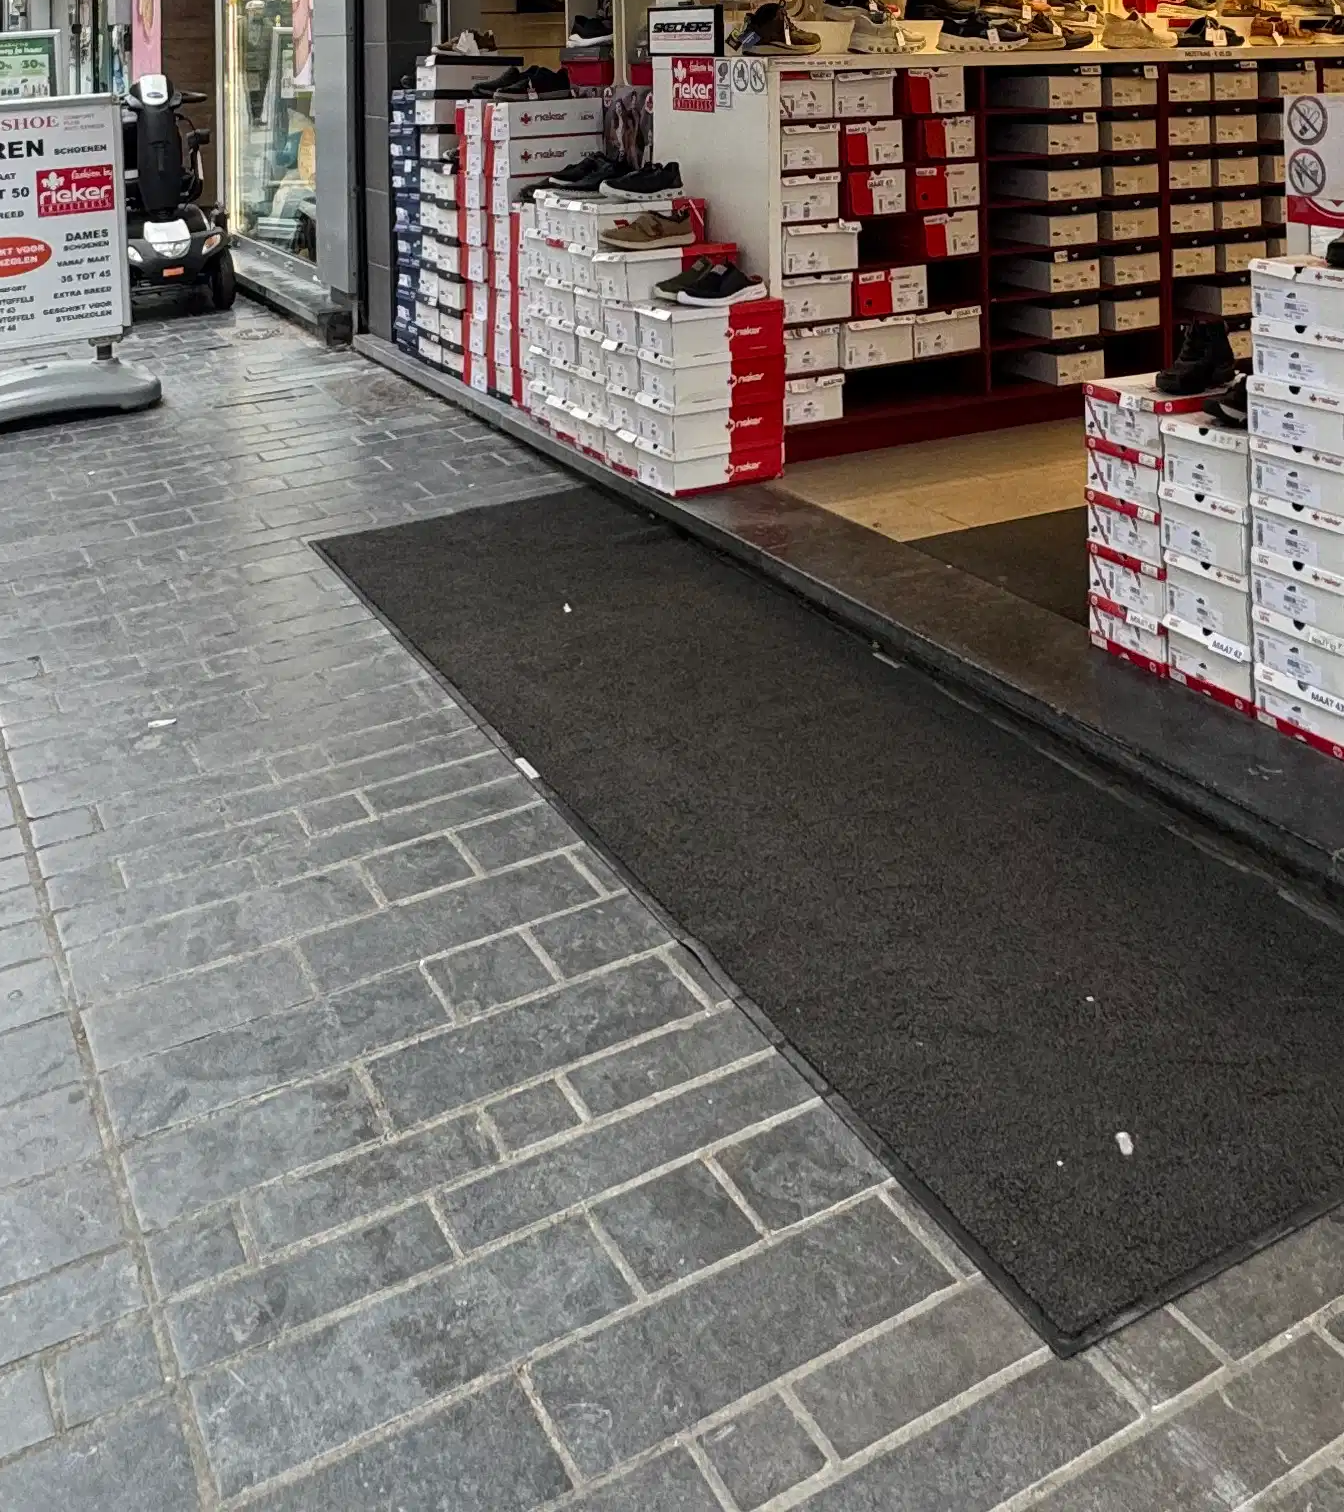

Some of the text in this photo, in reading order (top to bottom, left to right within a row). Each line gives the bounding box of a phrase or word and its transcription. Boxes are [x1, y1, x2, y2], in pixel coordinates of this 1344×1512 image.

[652, 21, 714, 34] SKECHERS
[673, 76, 712, 100] rieker
[1, 116, 59, 132] SHOE
[54, 144, 107, 155] SCHOENEN
[11, 187, 30, 198] 50
[39, 183, 113, 206] rieker
[65, 229, 109, 241] DAMES
[16, 244, 45, 254] VOOR
[77, 272, 96, 281] TOT
[1211, 639, 1231, 656] MAAT
[1311, 691, 1344, 713] MAAT 43
